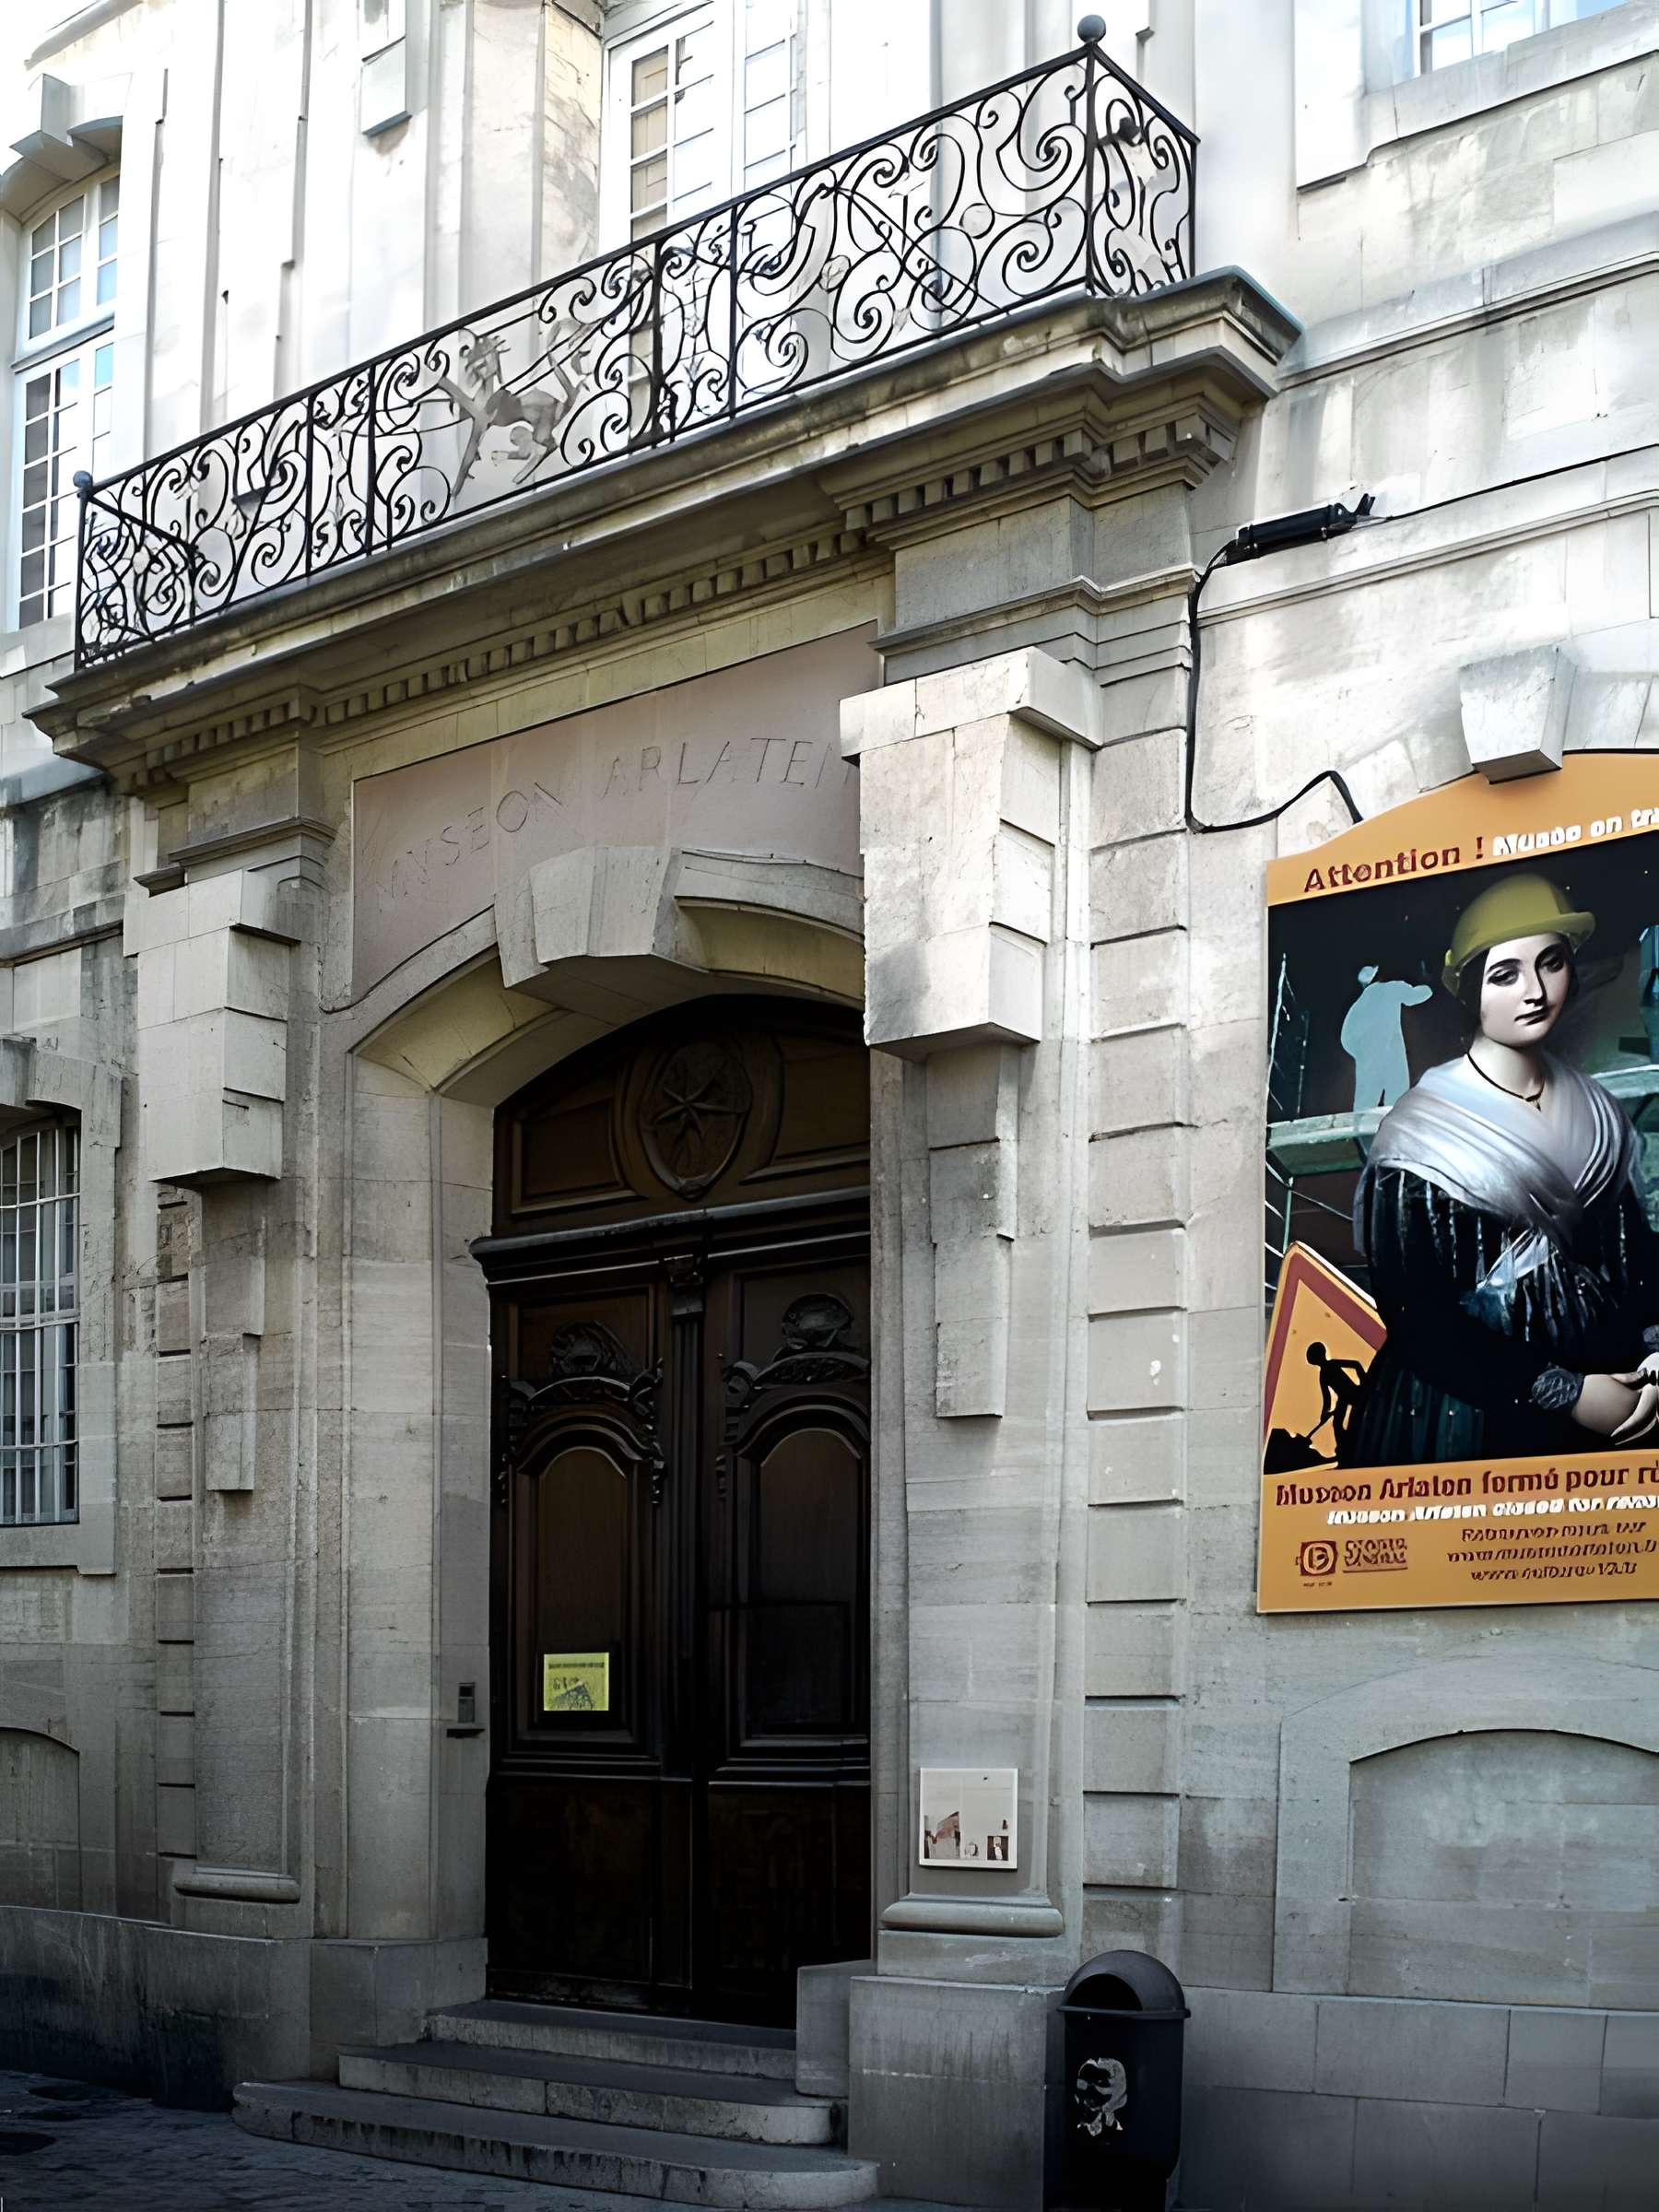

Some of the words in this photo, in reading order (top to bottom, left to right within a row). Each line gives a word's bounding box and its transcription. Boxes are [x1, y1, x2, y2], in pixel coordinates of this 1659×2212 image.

[1304, 846, 1461, 893] Attention
[1476, 836, 1484, 859] !
[1566, 1468, 1630, 1492] pour
